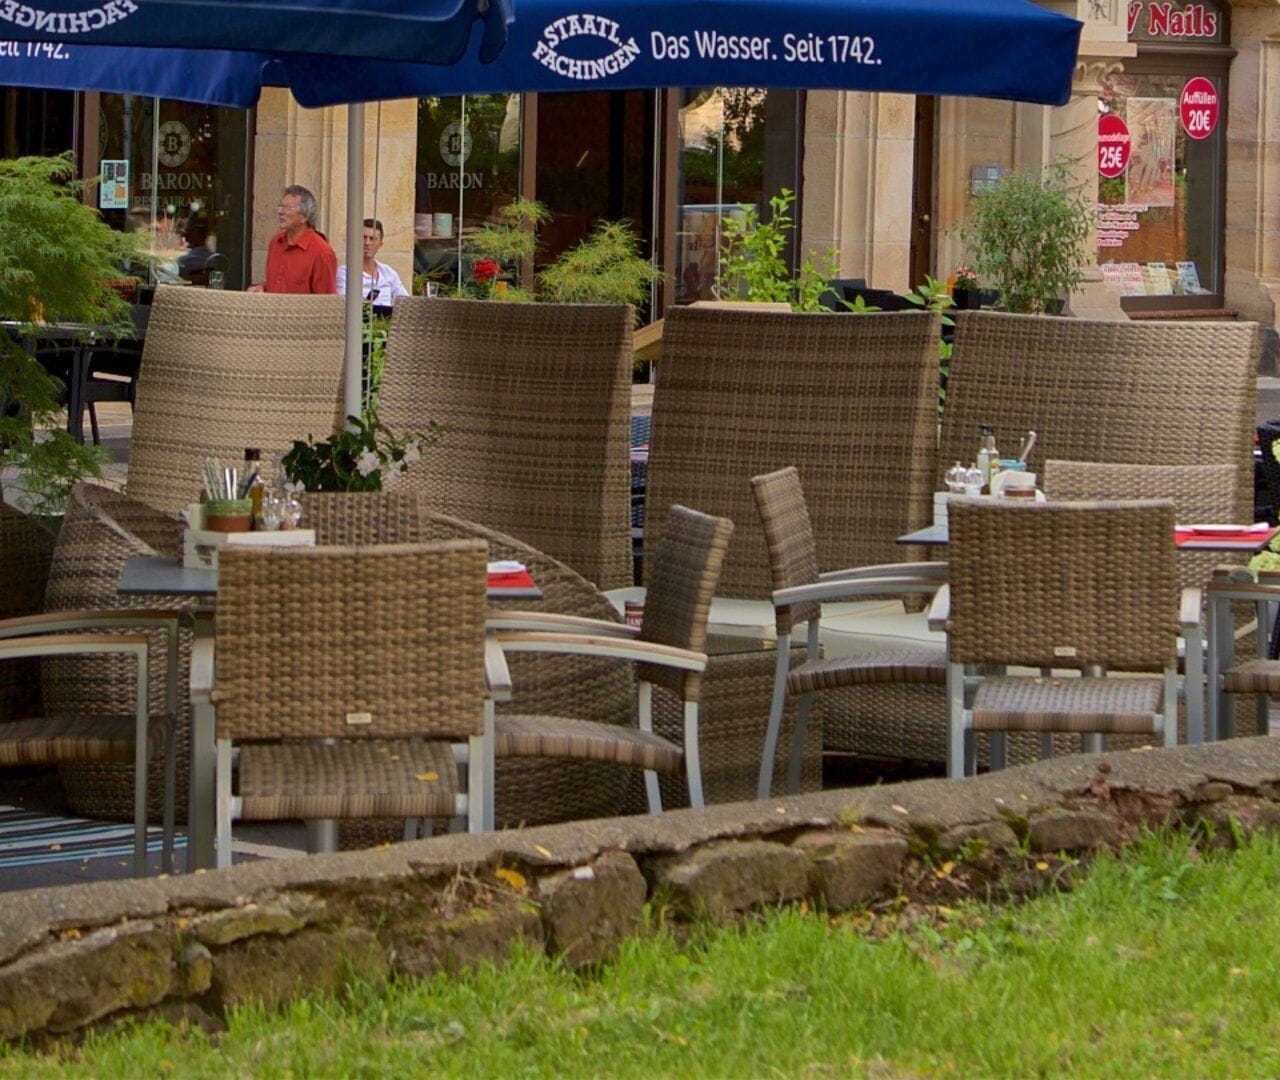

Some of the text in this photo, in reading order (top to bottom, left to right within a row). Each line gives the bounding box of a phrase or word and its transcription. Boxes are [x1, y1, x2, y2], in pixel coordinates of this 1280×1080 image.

[1148, 3, 1217, 37] Nails
[543, 14, 622, 48] STAATL.
[651, 30, 882, 65] Das Wasser. Seit 1742.
[532, 37, 641, 80] FACHINGEN
[1183, 91, 1217, 104] Auffüllen
[1189, 110, 1210, 131] 20€
[167, 135, 179, 152] B
[1100, 146, 1123, 168] 25€
[141, 172, 205, 191] BARON
[427, 172, 484, 189] BARON
